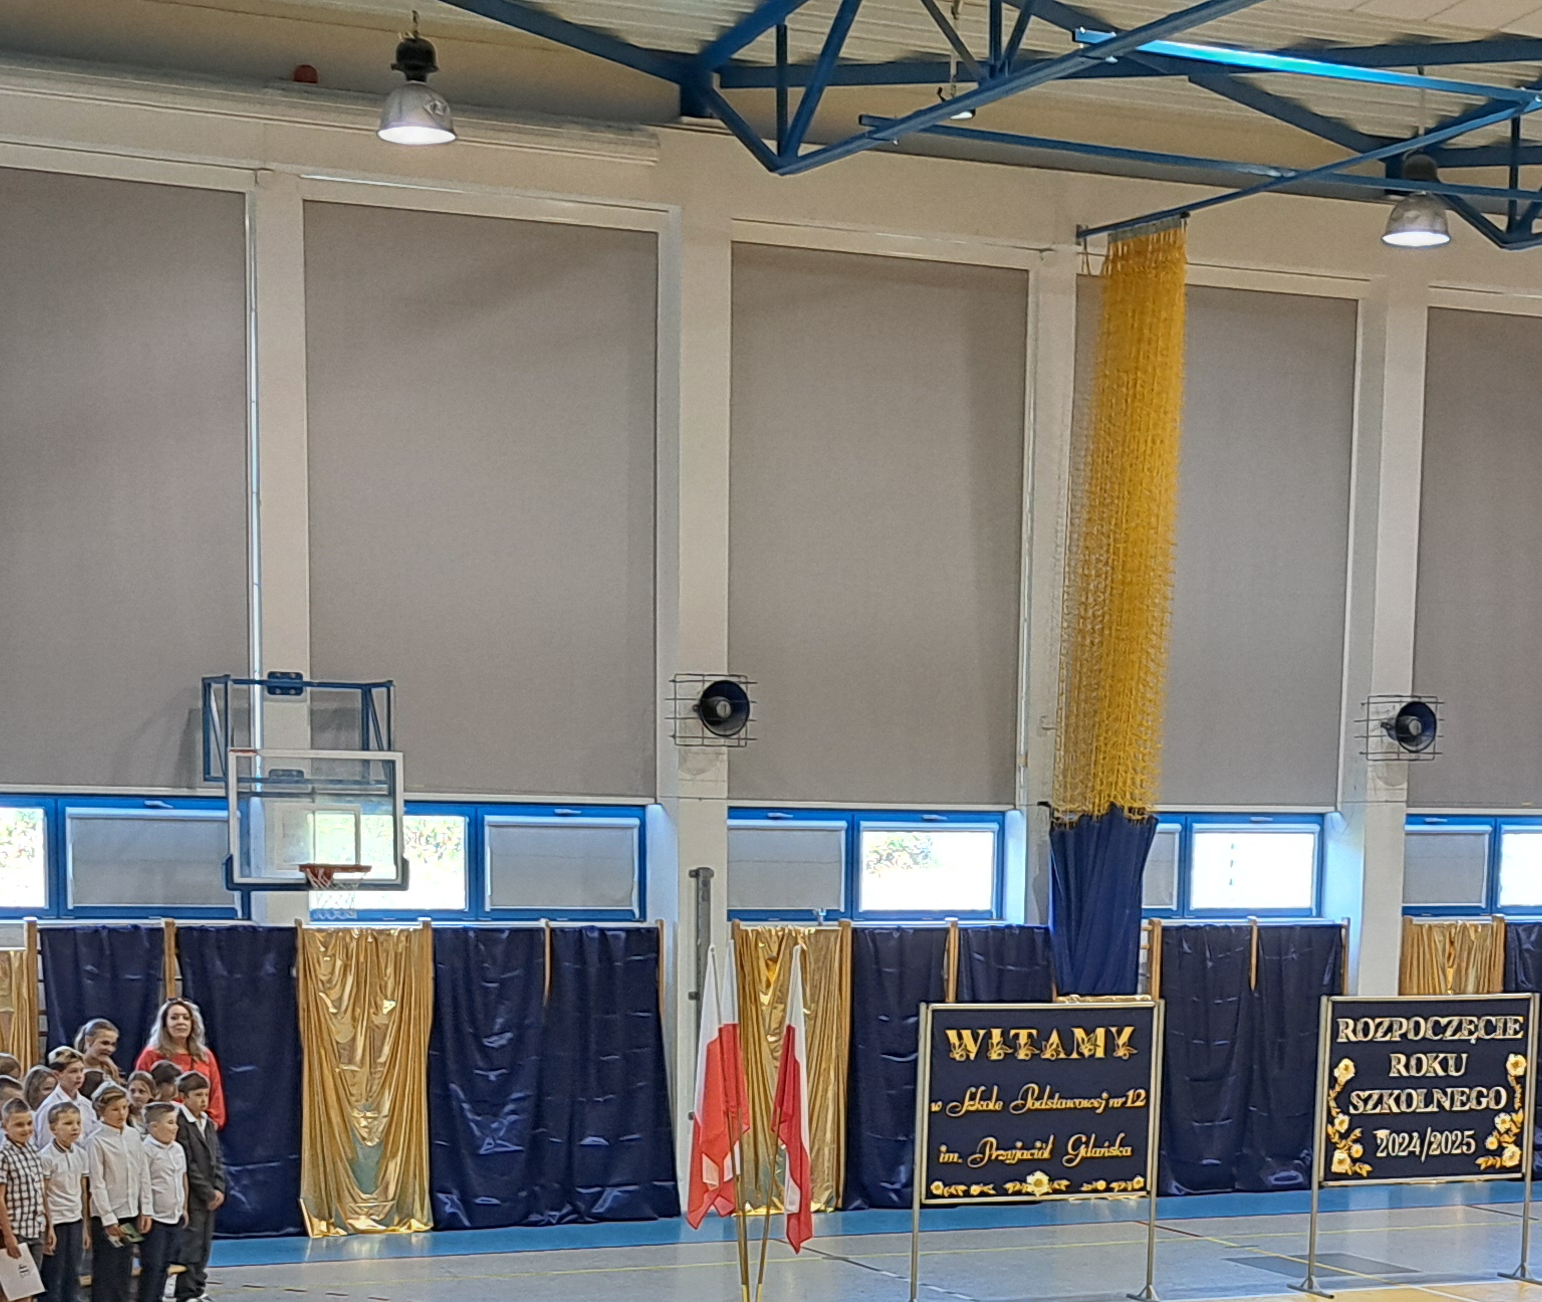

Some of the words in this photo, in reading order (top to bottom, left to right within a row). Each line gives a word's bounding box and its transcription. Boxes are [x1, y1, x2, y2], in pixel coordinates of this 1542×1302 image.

[945, 1026, 1138, 1062] WITAMY
[1336, 1015, 1524, 1045] ROZPOCZĘCIE
[1388, 1052, 1468, 1077] ROKU
[930, 1101, 943, 1112] w
[1009, 1083, 1109, 1114] Podstawowej
[1124, 1088, 1147, 1107] 12
[1348, 1086, 1508, 1115] SZKOLNEGO
[939, 1145, 963, 1163] im.
[1062, 1132, 1132, 1167] Gdańska
[1373, 1126, 1477, 1164] 2024/2025
